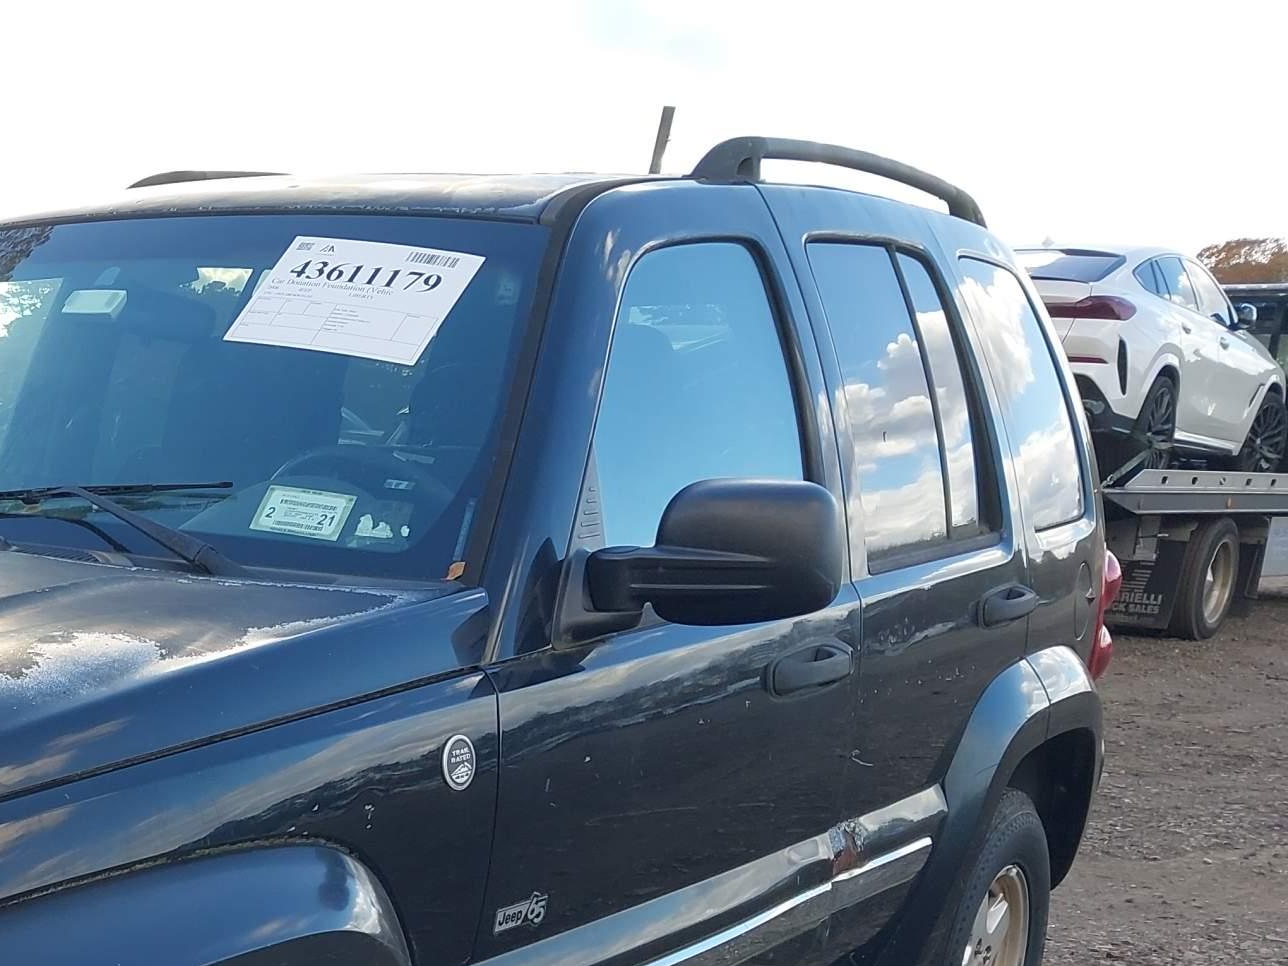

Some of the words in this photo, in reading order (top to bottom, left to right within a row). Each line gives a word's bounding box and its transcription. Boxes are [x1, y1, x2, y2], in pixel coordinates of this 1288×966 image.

[289, 259, 443, 293] 43611179
[286, 279, 321, 288] Donation
[322, 282, 366, 293] Foundation
[264, 506, 277, 519] 2
[316, 513, 336, 527] 21
[1127, 603, 1160, 614] SALES
[450, 753, 471, 763] RATED
[498, 909, 523, 926] Jeep
[527, 893, 549, 924] 65
